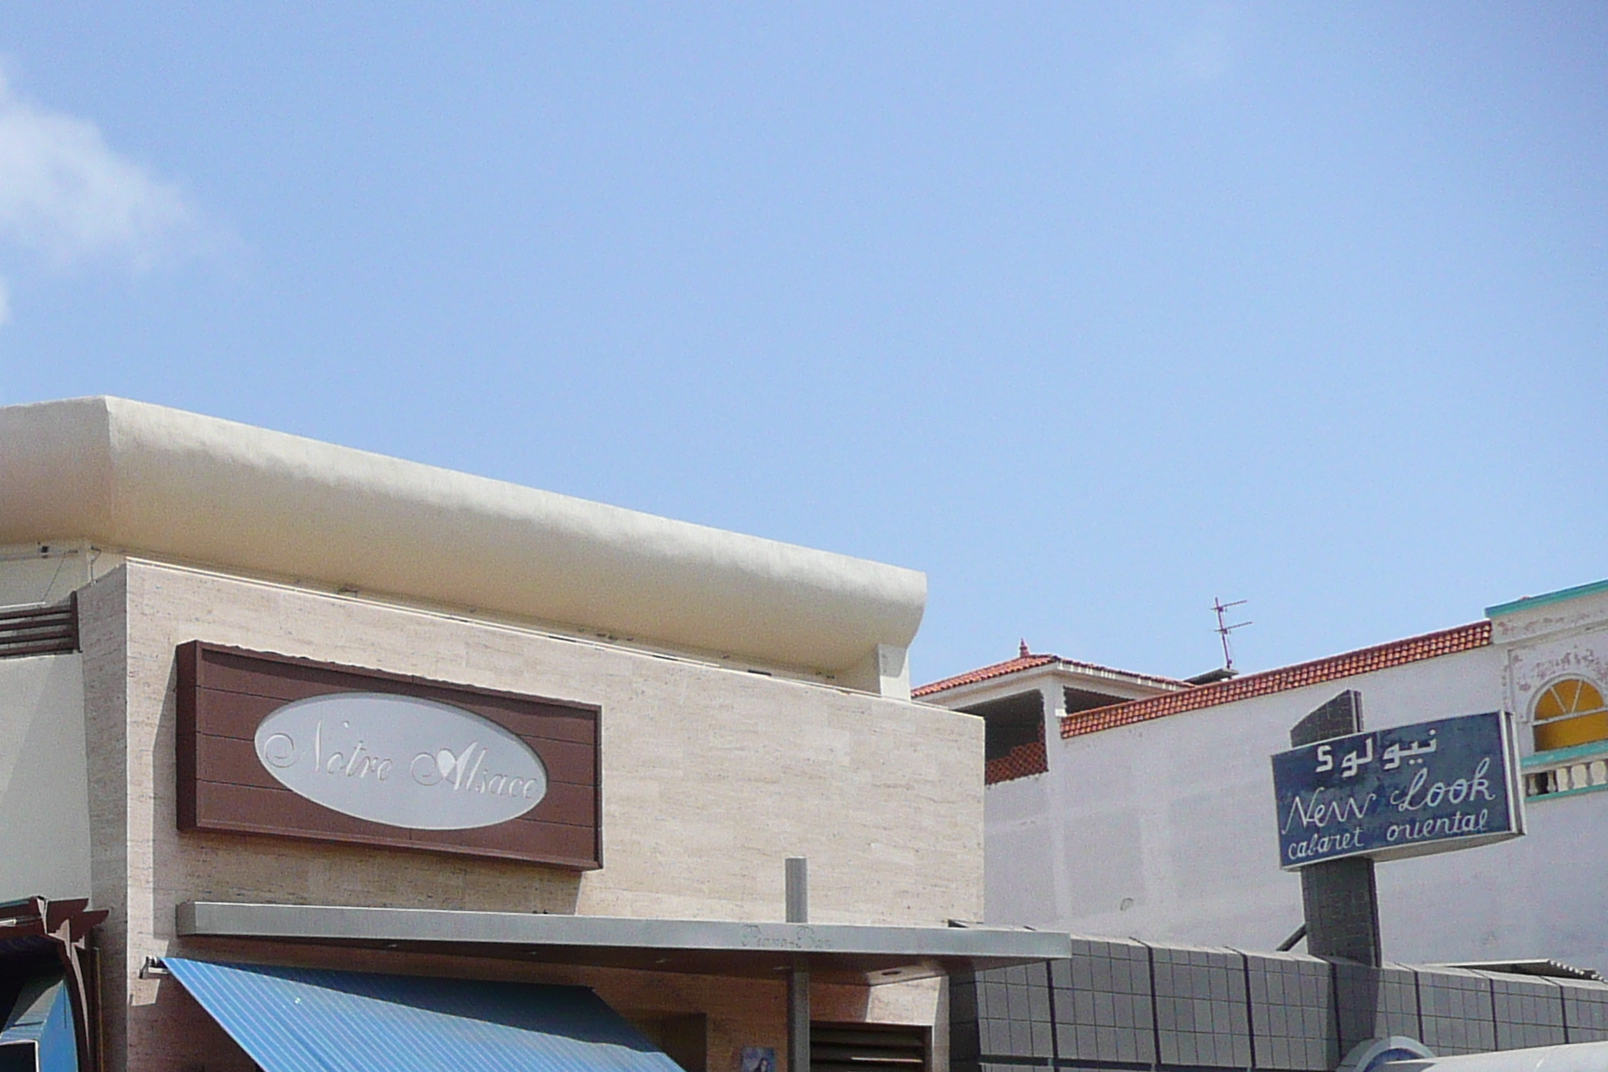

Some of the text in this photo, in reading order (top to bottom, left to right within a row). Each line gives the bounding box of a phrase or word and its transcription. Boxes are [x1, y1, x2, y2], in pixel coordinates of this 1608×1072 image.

[1281, 757, 1496, 835] New Look
[1288, 809, 1489, 860] cabaret oriental
